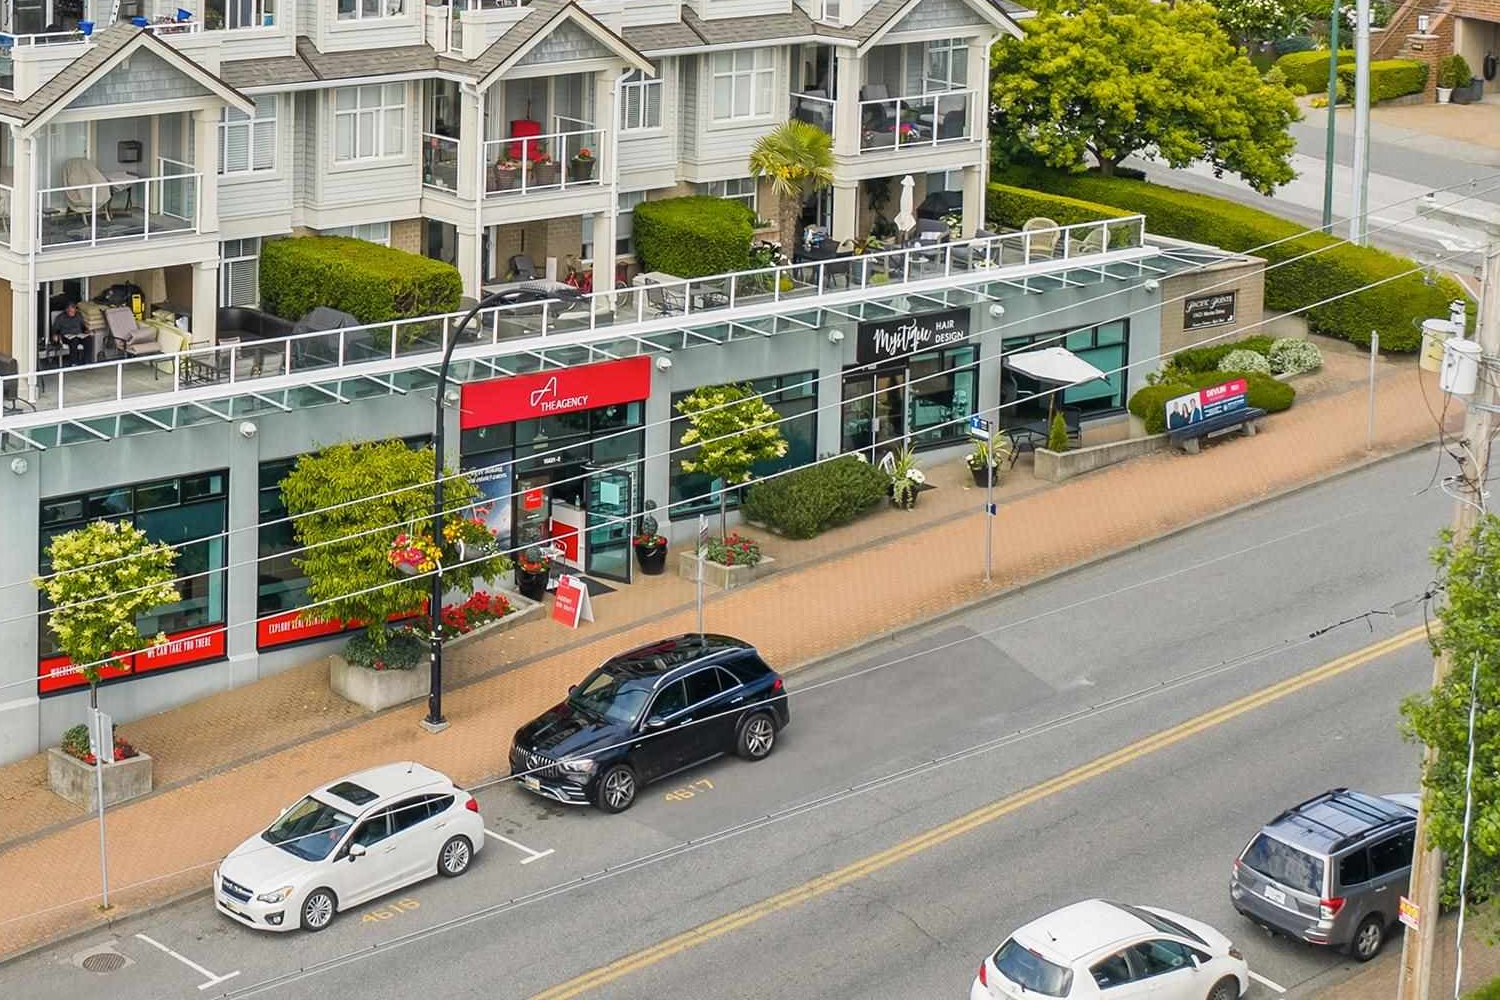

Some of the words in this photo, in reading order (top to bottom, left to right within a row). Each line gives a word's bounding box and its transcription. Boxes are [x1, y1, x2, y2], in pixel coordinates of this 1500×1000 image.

[935, 320, 955, 331] HAIR
[935, 331, 964, 343] DESIGN
[156, 645, 168, 656] CAN
[168, 641, 182, 654] TAKE
[183, 639, 195, 651] YOU
[195, 635, 212, 648] THERE
[363, 898, 421, 921] 4616
